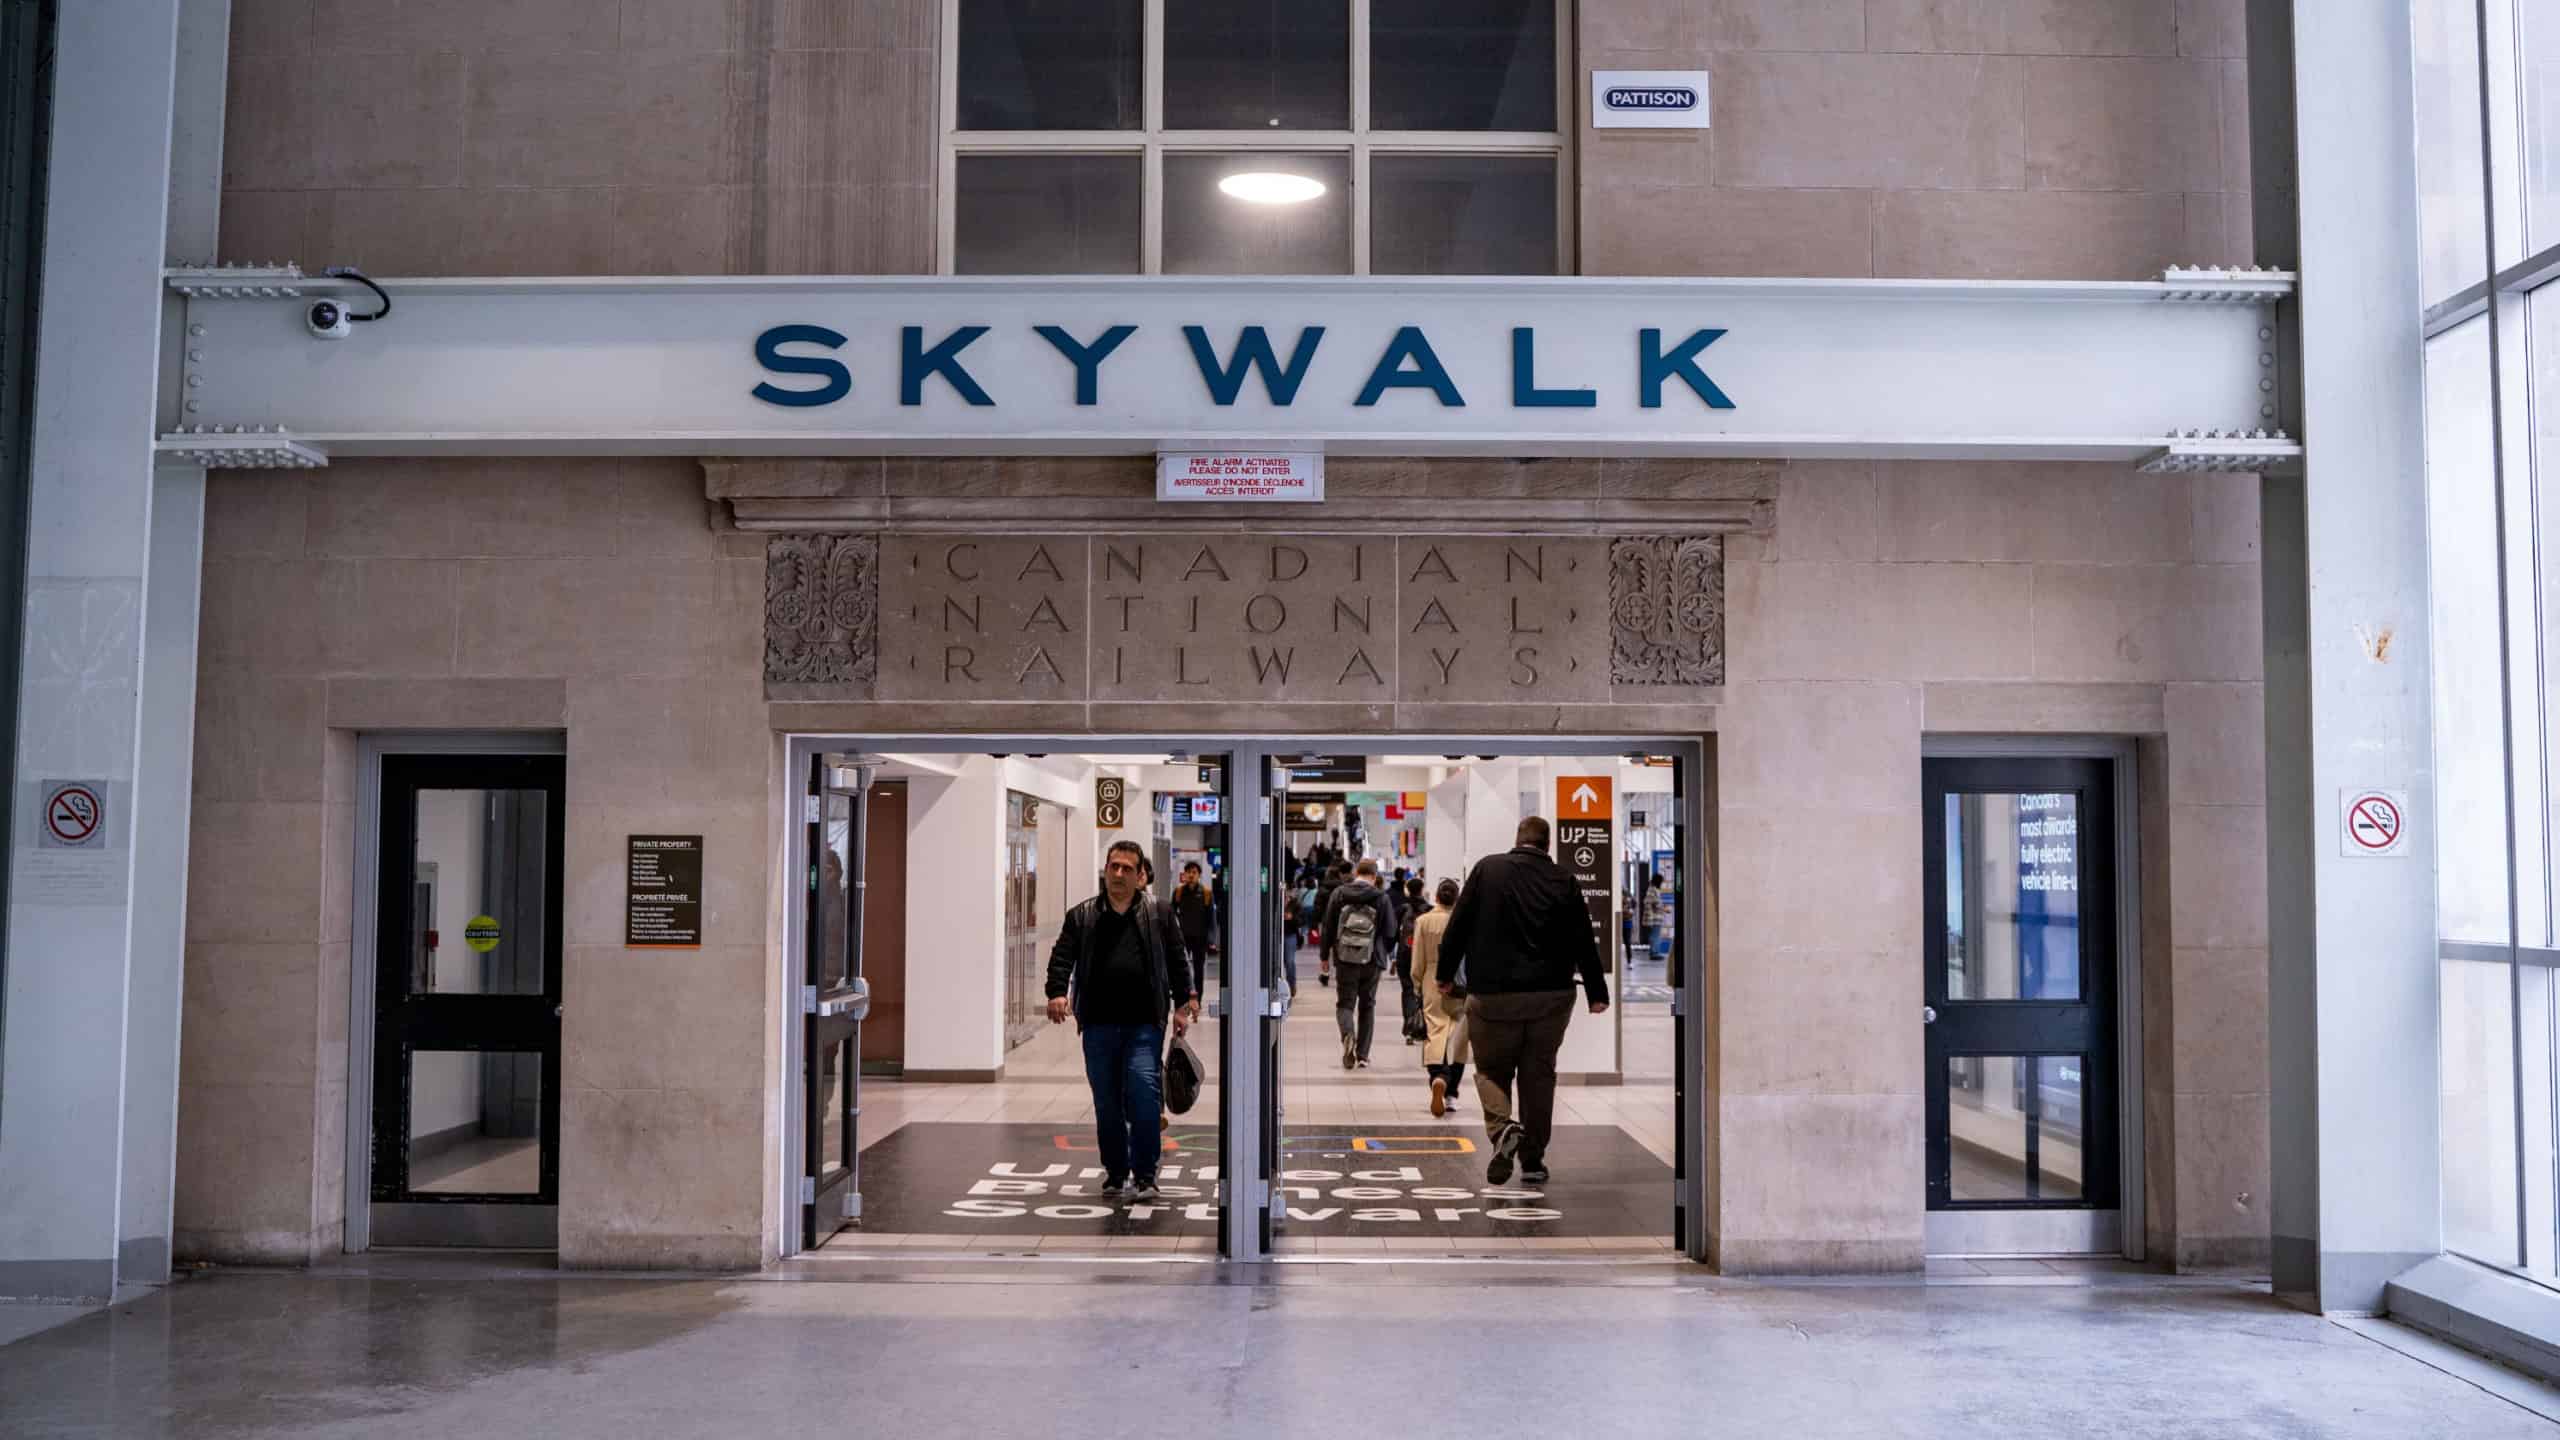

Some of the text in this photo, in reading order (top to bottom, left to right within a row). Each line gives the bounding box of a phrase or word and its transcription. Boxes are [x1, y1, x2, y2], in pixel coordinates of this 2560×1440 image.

[1611, 92, 1690, 105] PATTISON
[752, 324, 1736, 409] SKYWALK
[1189, 467, 1290, 475] PLEASE DO NOT ENTER
[1190, 458, 1290, 466] FIRE ALARM ACTIVATED
[1174, 478, 1220, 487] AVERTISSEUR
[1238, 487, 1276, 496] INTERDIT
[945, 543, 1543, 583] CANADIAN
[943, 594, 1544, 634] NATIONAL
[943, 646, 1540, 687] RAILWAYS
[2020, 815, 2077, 837] most awarde
[632, 840, 692, 848] PRIVATE PROPERTY
[1560, 827, 1586, 844] UP
[2021, 841, 2072, 868] fully electric
[1573, 873, 1597, 881] WALK
[2021, 869, 2077, 890] vehicle line-u
[967, 1180, 1545, 1199] Busness
